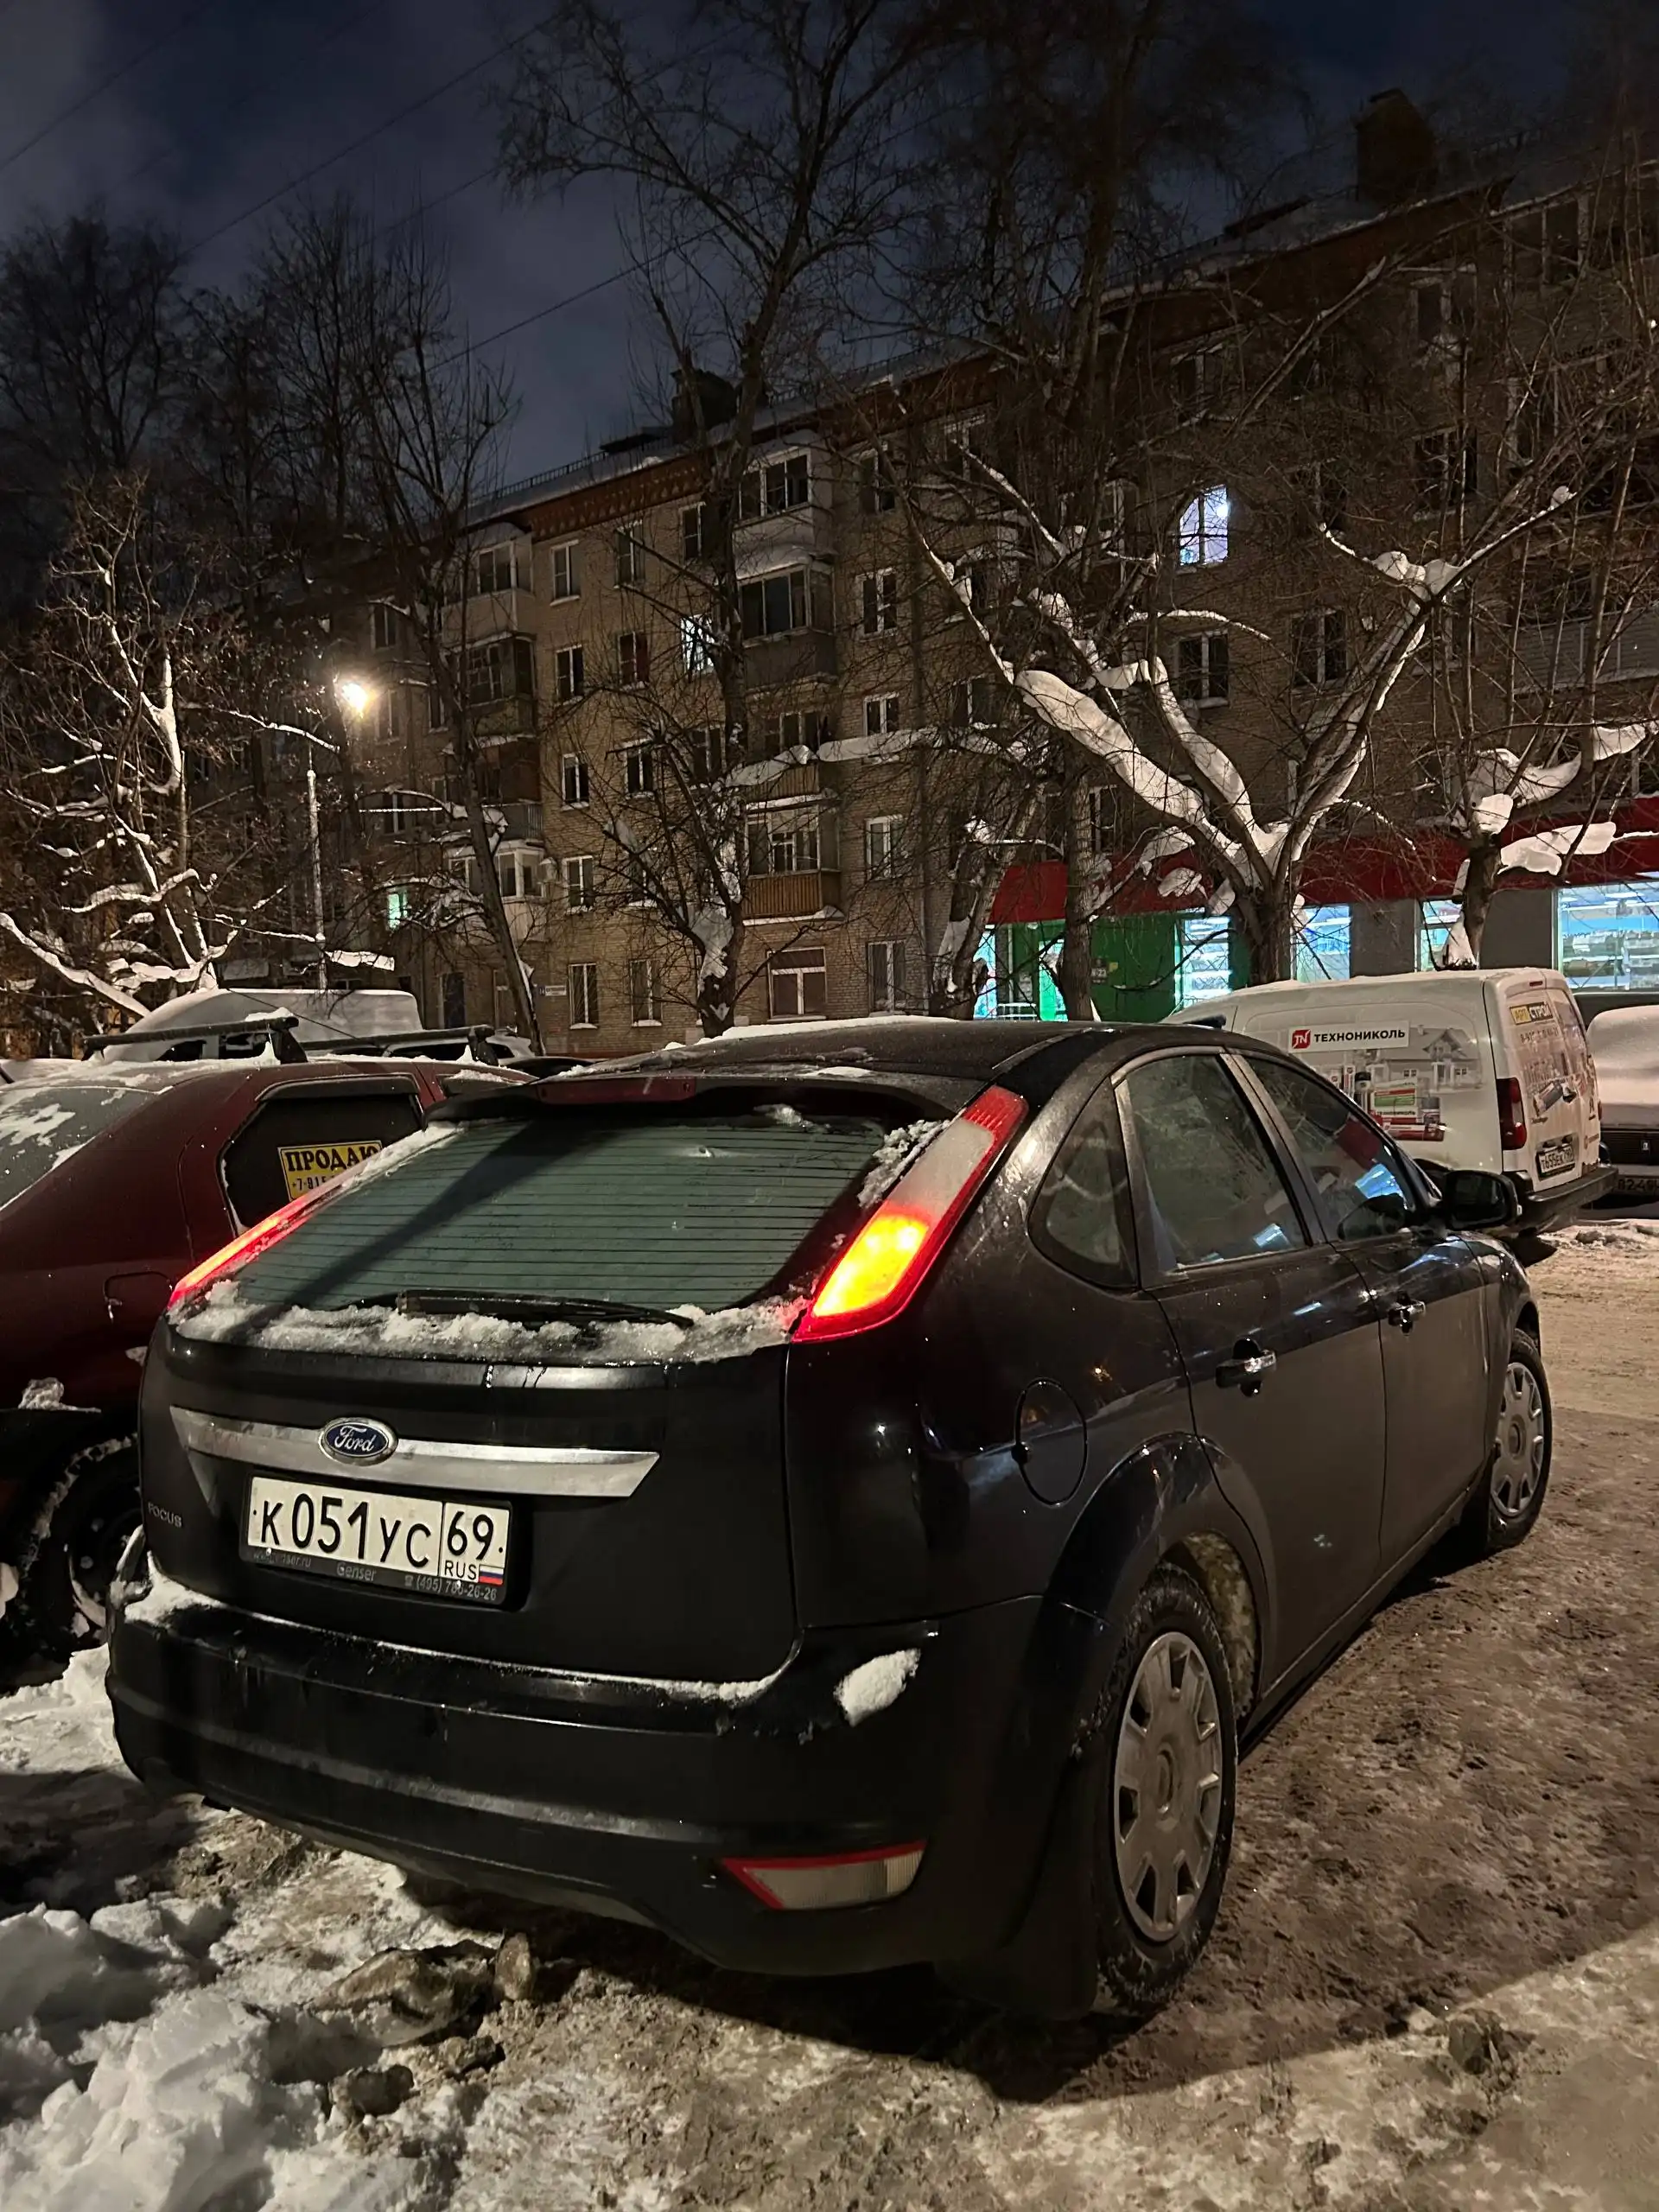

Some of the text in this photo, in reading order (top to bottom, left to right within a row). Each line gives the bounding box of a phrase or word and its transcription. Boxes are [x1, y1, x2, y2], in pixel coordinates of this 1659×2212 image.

[1313, 1029, 1406, 1043] ТЕХНОНИКОЛЬ
[334, 1425, 374, 1452] Ford
[148, 1502, 182, 1528] FOCUS
[447, 1510, 494, 1560] 69
[336, 1561, 377, 1582] Genser
[444, 1560, 477, 1580] RUS
[416, 1574, 442, 1594] (495)
